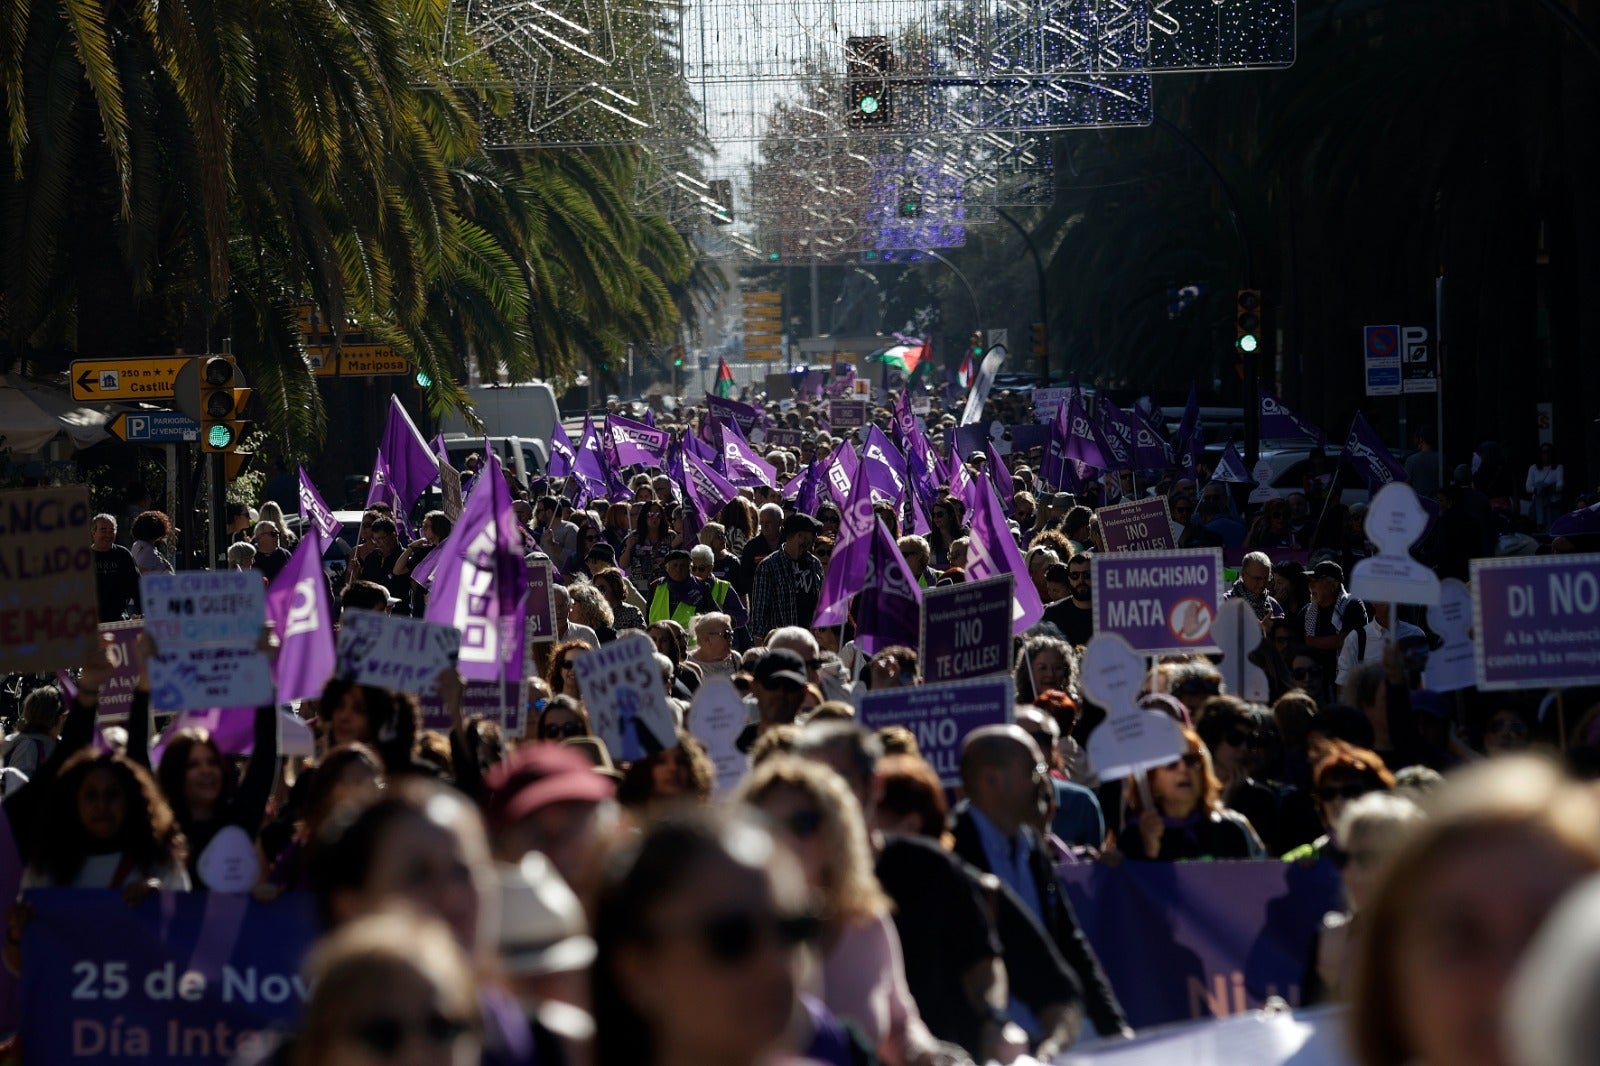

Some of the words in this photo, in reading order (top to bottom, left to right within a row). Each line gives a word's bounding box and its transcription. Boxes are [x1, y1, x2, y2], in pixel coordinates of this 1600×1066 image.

[348, 360, 404, 371] Mariposa
[132, 419, 145, 437] P
[1104, 517, 1132, 528] Violencia
[1132, 514, 1141, 522] de
[1140, 510, 1164, 521] Género
[1120, 507, 1136, 516] Ante
[1136, 506, 1142, 514] la
[1126, 522, 1149, 541] ¡NO
[1106, 569, 1123, 590] EL
[1126, 564, 1209, 588] MACHISMO
[953, 592, 973, 604] Ante
[1508, 584, 1535, 617] DI
[1547, 571, 1600, 616] NO
[928, 607, 966, 623] Violencia
[967, 606, 978, 616] de
[978, 599, 1007, 613] Género
[1107, 599, 1166, 628] MATA
[954, 617, 983, 649] ¡NO
[1504, 631, 1517, 646] A
[1518, 629, 1535, 645] la
[936, 655, 951, 679] TE
[953, 644, 1000, 676] CALLES!
[1486, 654, 1538, 669] contra
[1539, 650, 1563, 665] las
[109, 677, 118, 688] A
[120, 676, 131, 688] la
[866, 708, 928, 723] Violencia
[930, 705, 948, 717] de
[70, 961, 130, 1000] 25
[143, 961, 208, 1002] de
[72, 1014, 151, 1058] Día
